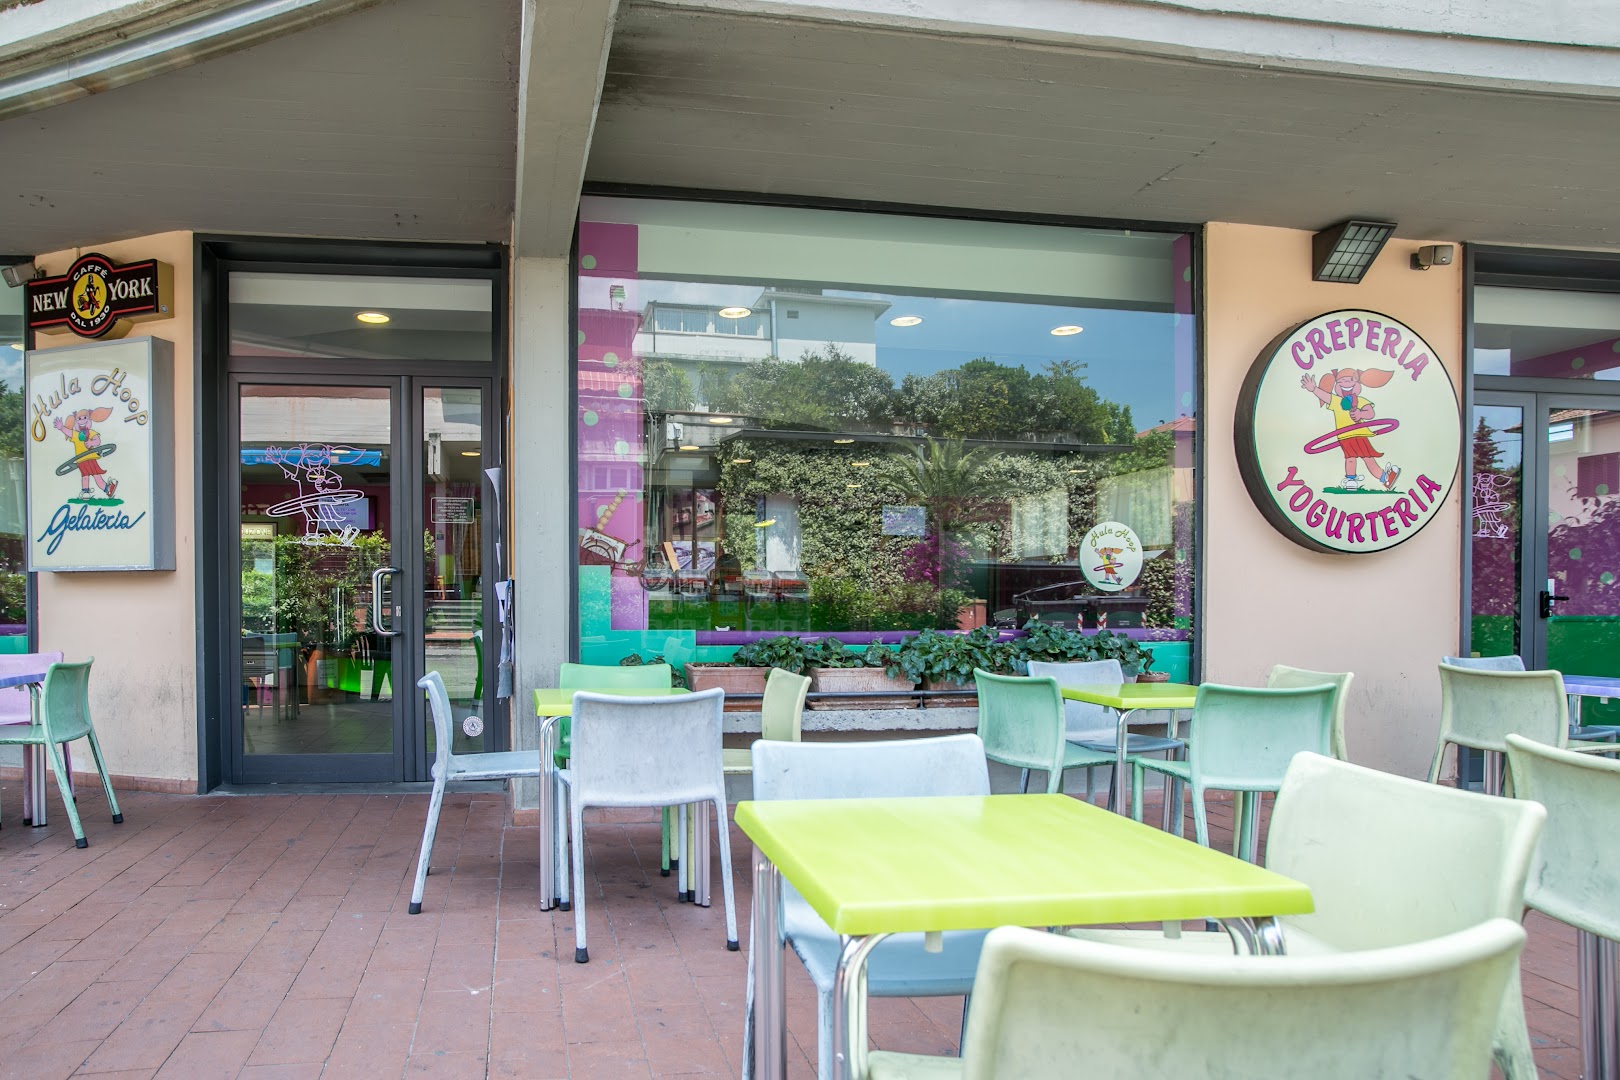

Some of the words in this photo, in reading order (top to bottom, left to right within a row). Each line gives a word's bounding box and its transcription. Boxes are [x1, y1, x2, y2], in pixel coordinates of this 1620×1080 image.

[73, 264, 108, 281] CAFFÉ
[33, 286, 69, 313] NEW
[108, 274, 153, 301] YORK
[70, 312, 87, 328] DAL
[89, 305, 110, 327] 1930
[1291, 318, 1429, 381] CREPERIA
[31, 373, 82, 442] Hula
[91, 368, 148, 426] Hoop
[1277, 466, 1441, 543] YOGURTERIA
[1090, 525, 1113, 547] Hula
[1115, 529, 1136, 552] Hoop
